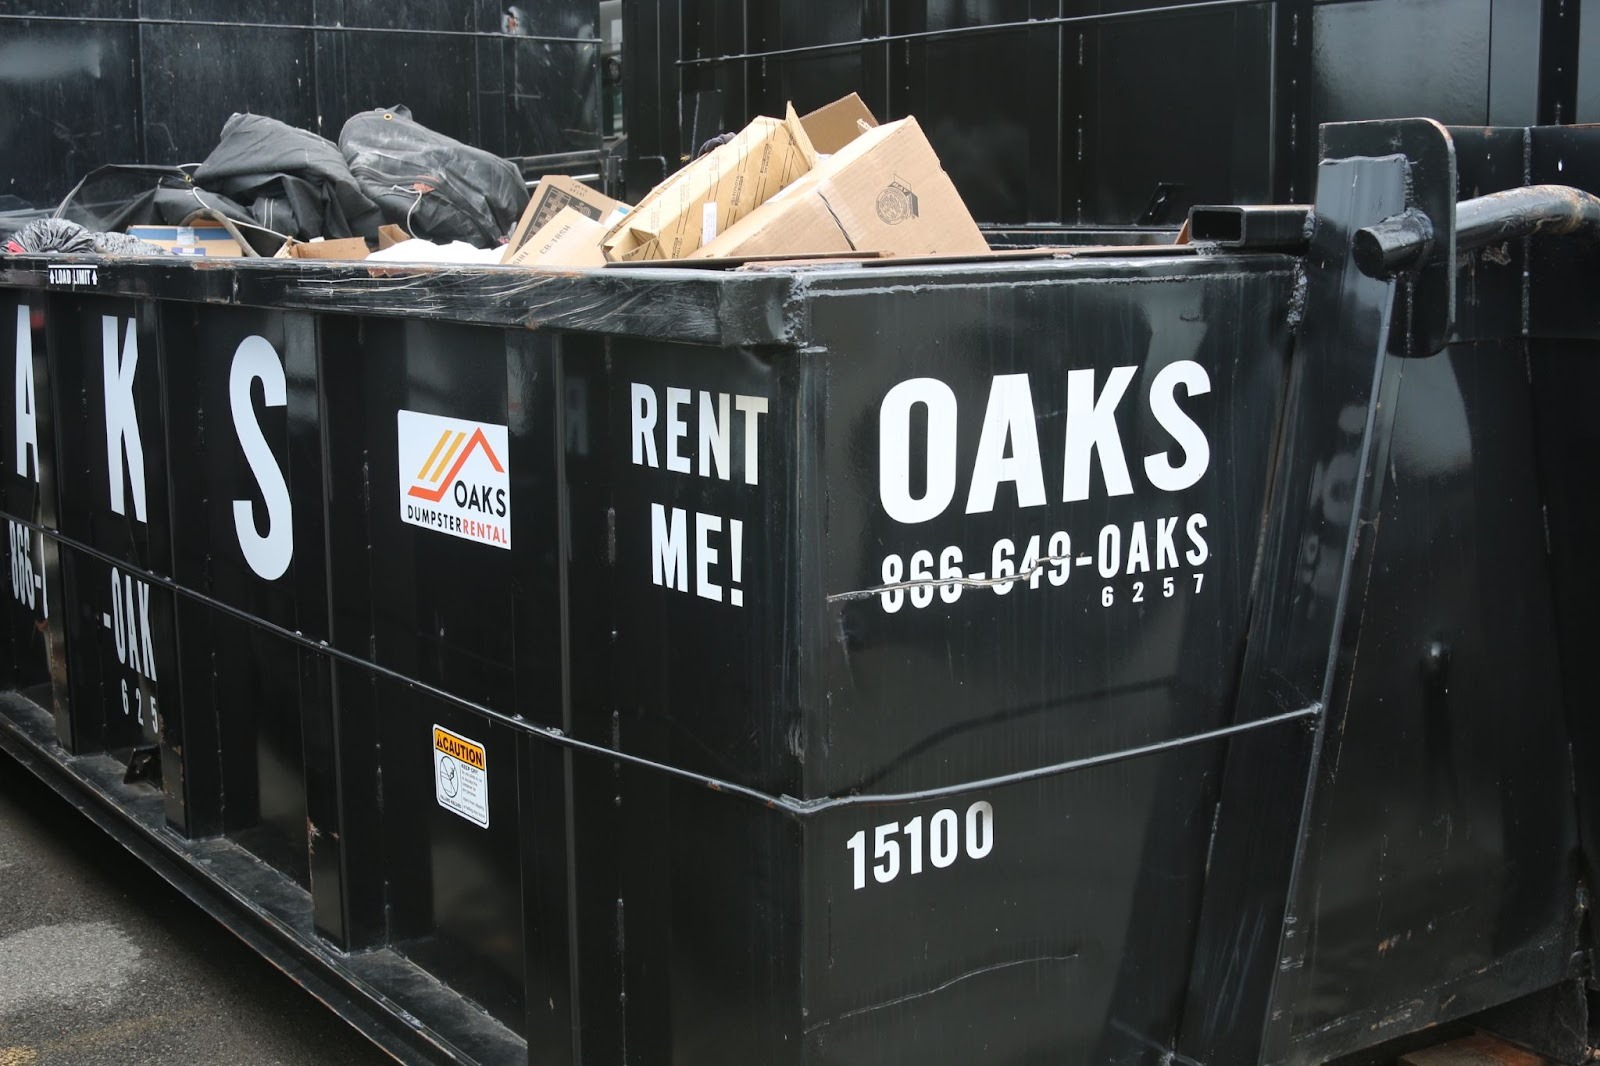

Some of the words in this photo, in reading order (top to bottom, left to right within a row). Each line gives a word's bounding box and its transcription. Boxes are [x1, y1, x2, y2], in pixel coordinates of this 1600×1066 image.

[55, 269, 71, 284] LOAD
[74, 269, 91, 285] LIMIT
[631, 382, 768, 486] RENT
[880, 359, 1212, 524] OAKS
[454, 480, 507, 518] OAKS
[651, 502, 744, 608] ME!
[880, 512, 1209, 614] 866-649-OAKS
[442, 737, 482, 767] CAUTION
[846, 800, 994, 891] 15100
